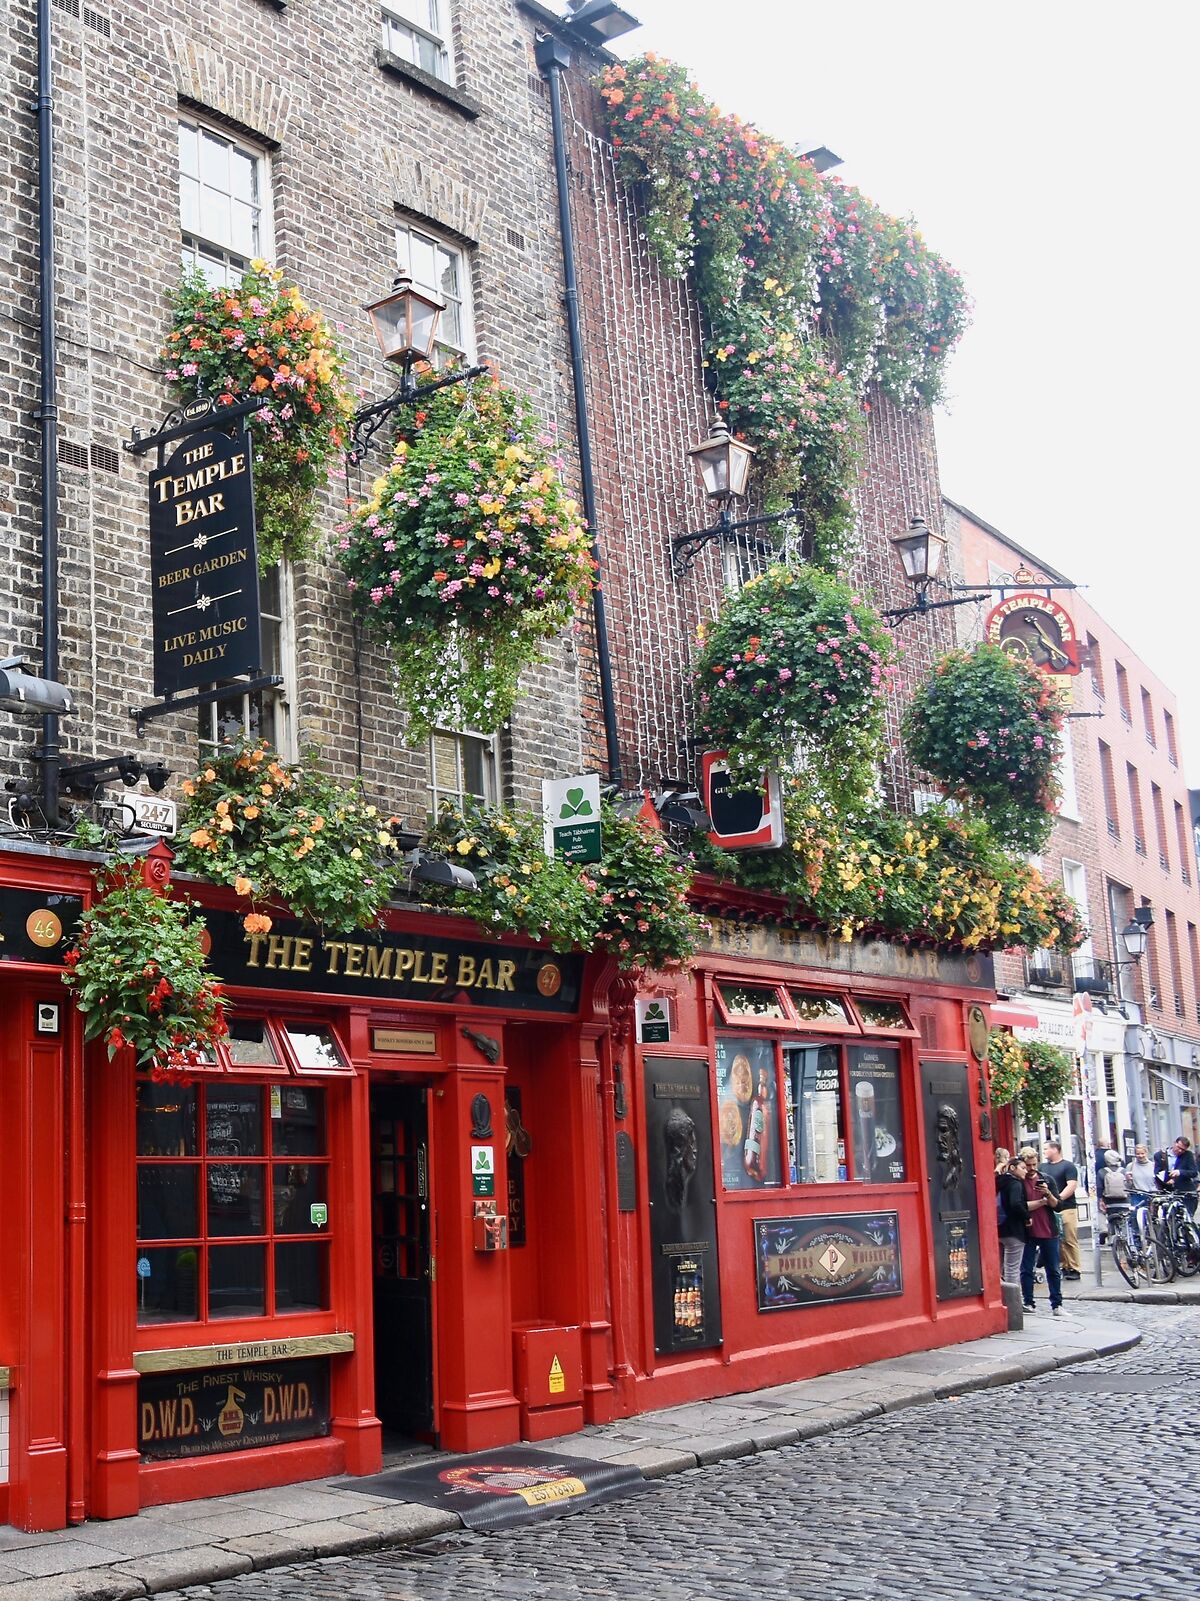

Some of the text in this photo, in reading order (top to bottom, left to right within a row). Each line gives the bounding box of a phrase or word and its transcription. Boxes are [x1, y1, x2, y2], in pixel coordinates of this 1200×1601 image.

[183, 442, 214, 465] THE
[153, 453, 246, 503] TEMPLE
[175, 492, 225, 527] BAR
[159, 548, 247, 588] BEER GARDEN
[164, 616, 247, 652] LIVE MUSIC
[990, 598, 1072, 643] THE TEMPLE BAR
[182, 644, 227, 668] DAILY
[33, 919, 55, 939] 46
[243, 932, 518, 992] THE TEMPLE BAR
[540, 971, 556, 989] 47
[778, 1248, 888, 1273] POWERS P WHISKEY
[216, 1344, 288, 1361] THE TEMPLE BAR
[141, 1397, 199, 1441] D.W.D.
[264, 1382, 314, 1424] D.W.D.
[534, 1489, 550, 1502] EST
